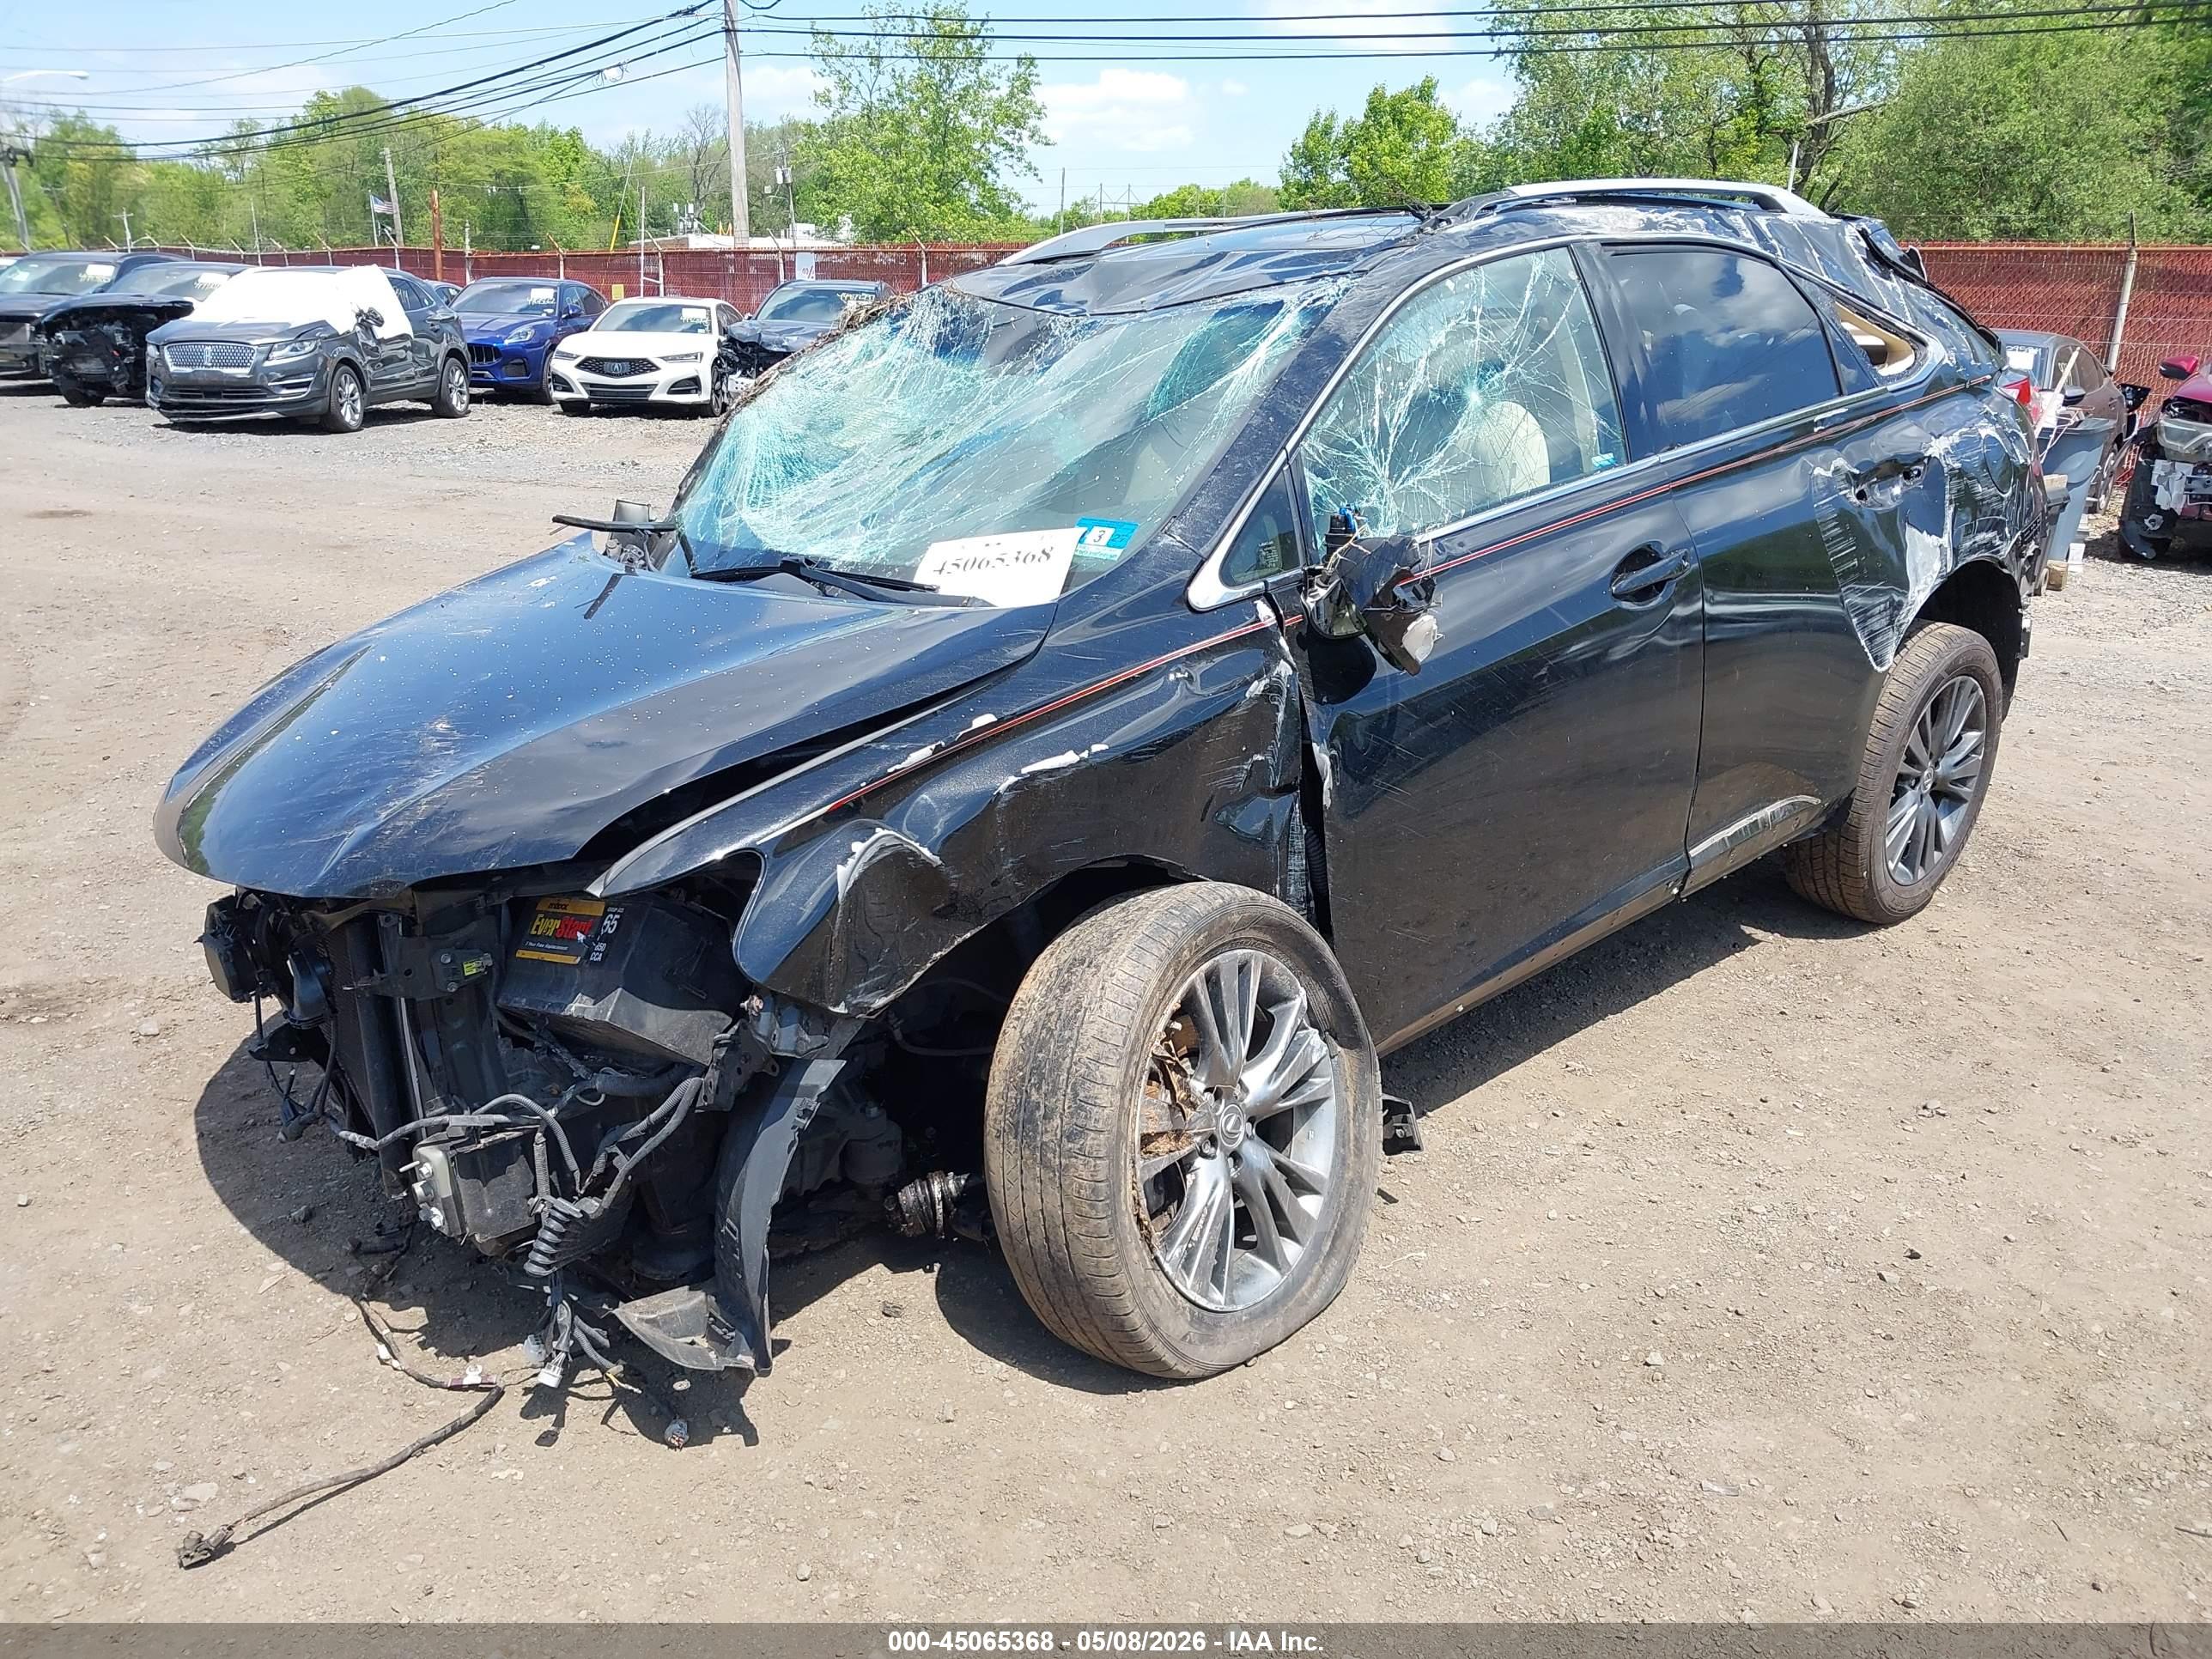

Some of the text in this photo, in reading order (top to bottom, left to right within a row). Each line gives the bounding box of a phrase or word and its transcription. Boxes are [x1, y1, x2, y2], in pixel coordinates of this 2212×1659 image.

[1093, 530, 1106, 543] 3
[530, 914, 592, 939] EverStart
[602, 914, 620, 933] 65
